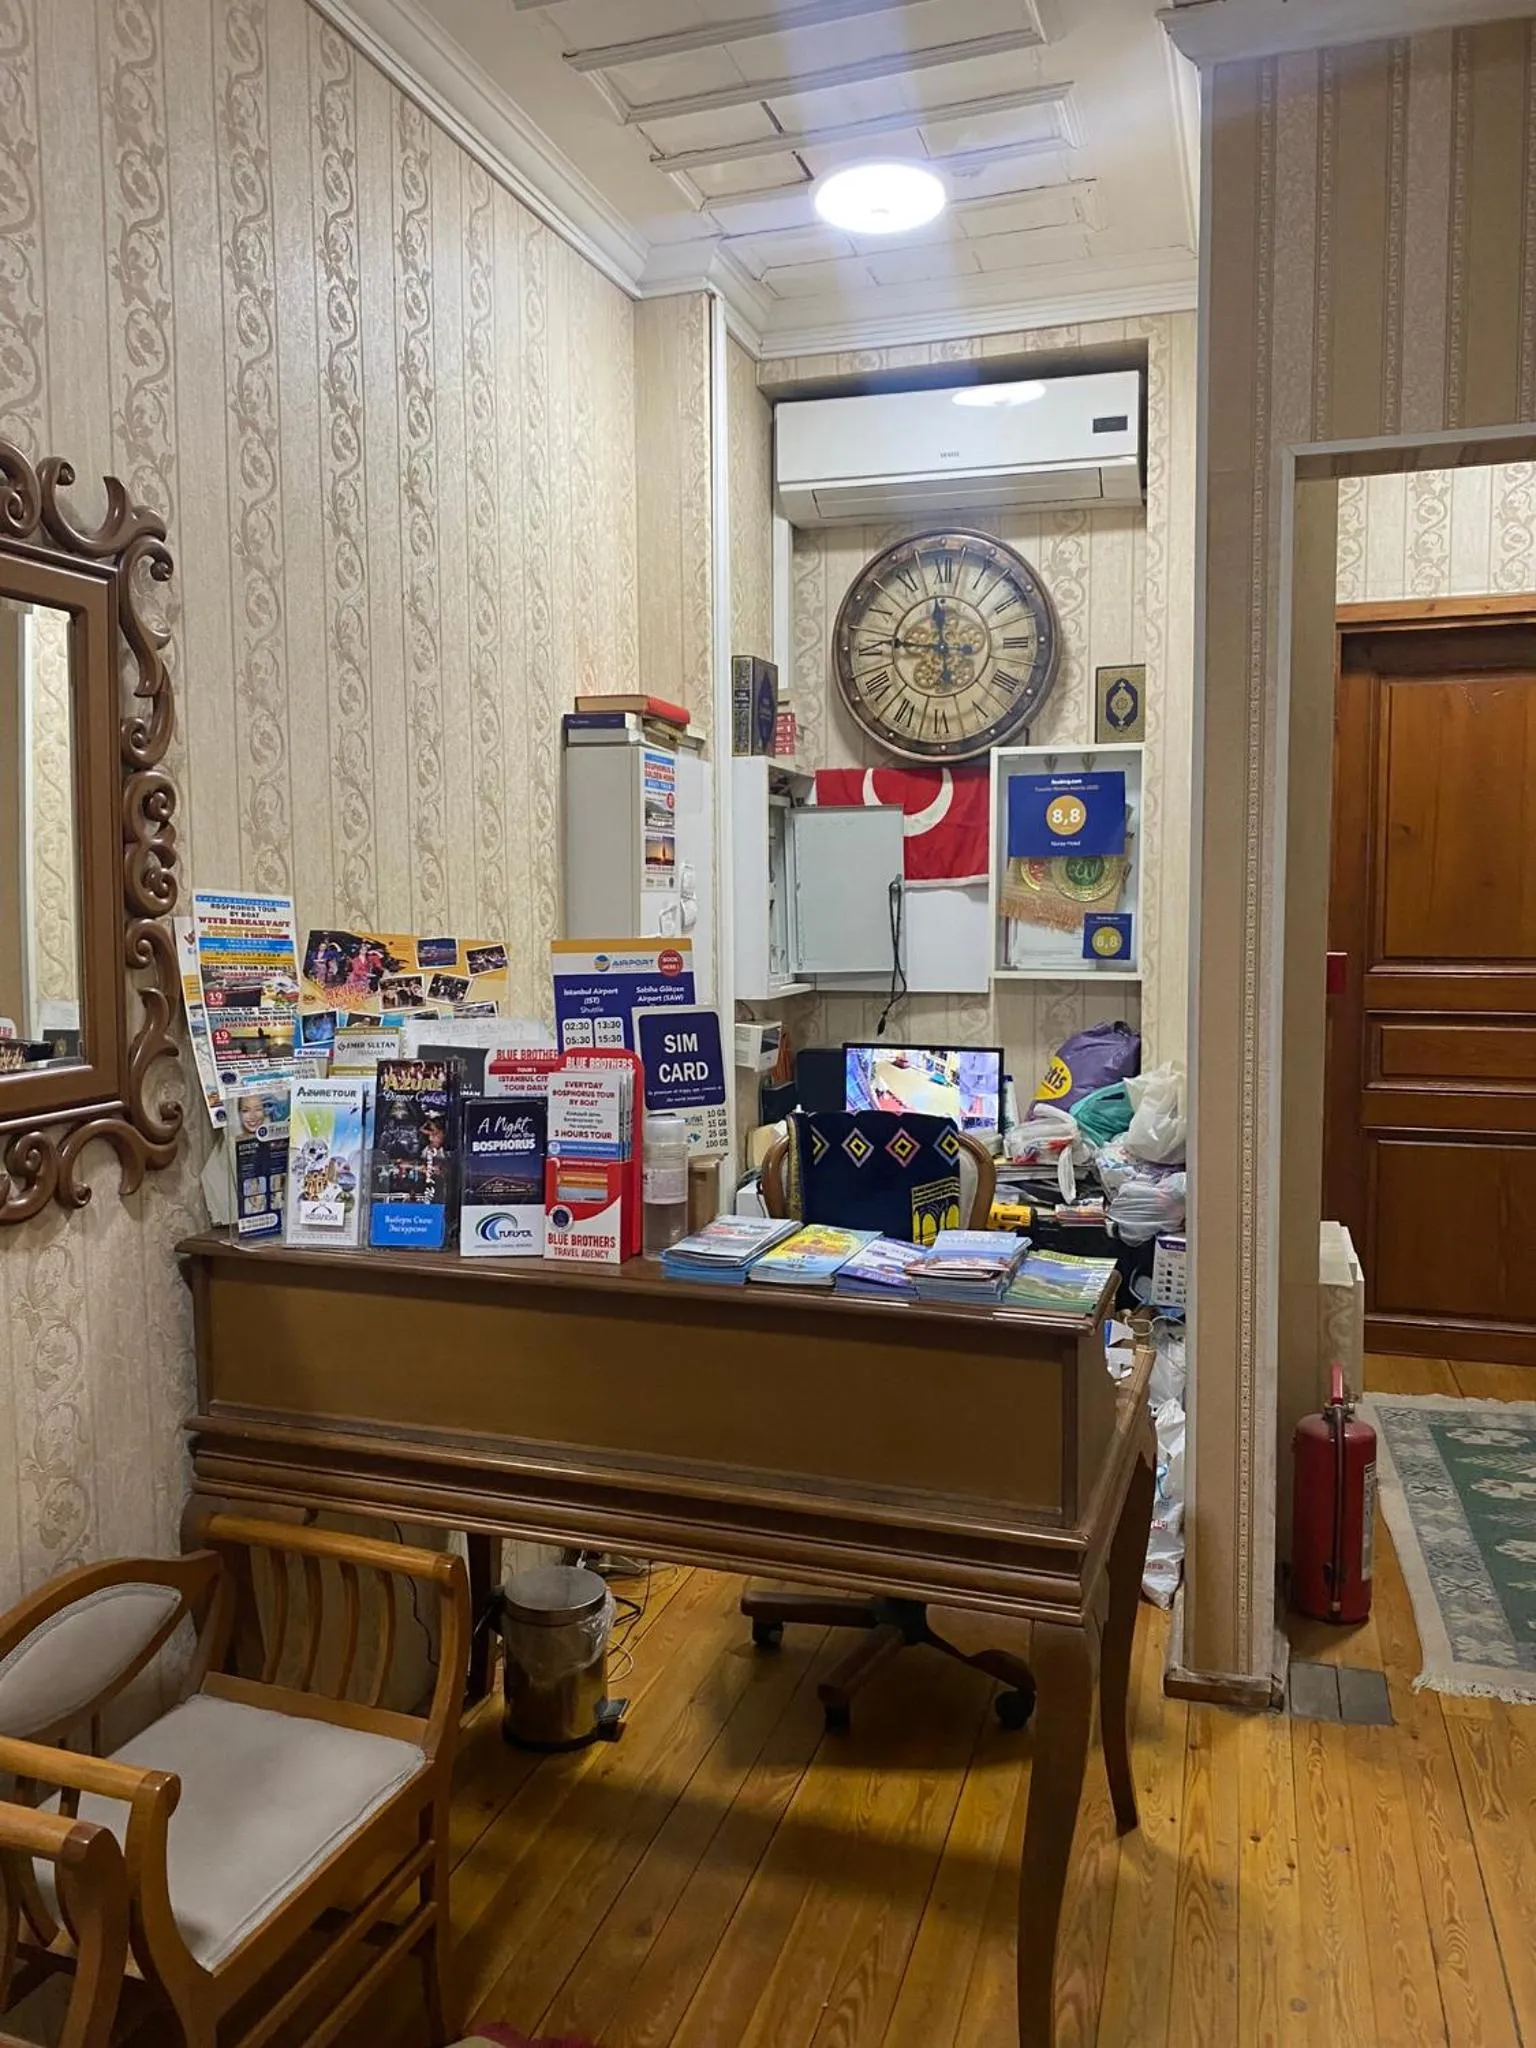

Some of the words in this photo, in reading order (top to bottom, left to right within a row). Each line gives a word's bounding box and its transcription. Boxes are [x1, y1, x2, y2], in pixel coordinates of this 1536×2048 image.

[1052, 807, 1081, 825] 8,8
[198, 917, 228, 925] WITH
[229, 918, 291, 928] BREAKFAST
[209, 992, 222, 1000] 19
[593, 988, 618, 996] Airport
[580, 1006, 604, 1014] Shuttle
[564, 1022, 589, 1030] 02:30
[597, 1021, 621, 1029] 13:30
[215, 1032, 228, 1040] 19
[598, 1035, 622, 1043] 15:30
[565, 1037, 590, 1045] 05:30
[664, 1033, 698, 1053] SIM
[496, 1050, 518, 1060] BLUE
[566, 1057, 587, 1069] BLUE
[589, 1058, 633, 1070] BROTHERS
[659, 1061, 709, 1083] CARD
[565, 1081, 603, 1089] EVERYDAY
[552, 1090, 595, 1098] BOSPHORUS
[717, 1109, 727, 1117] GB
[478, 1117, 490, 1134] A
[494, 1115, 533, 1139] Night
[561, 1130, 589, 1138] HOURS
[591, 1131, 612, 1139] TOUR
[472, 1139, 536, 1152] BOSPHORUS
[705, 1140, 718, 1148] 100
[719, 1138, 728, 1146] GB
[548, 1233, 568, 1245] BLUE
[571, 1235, 616, 1248] BROTHERS
[554, 1247, 579, 1257] TRAVEL
[581, 1248, 609, 1258] AGENCY
